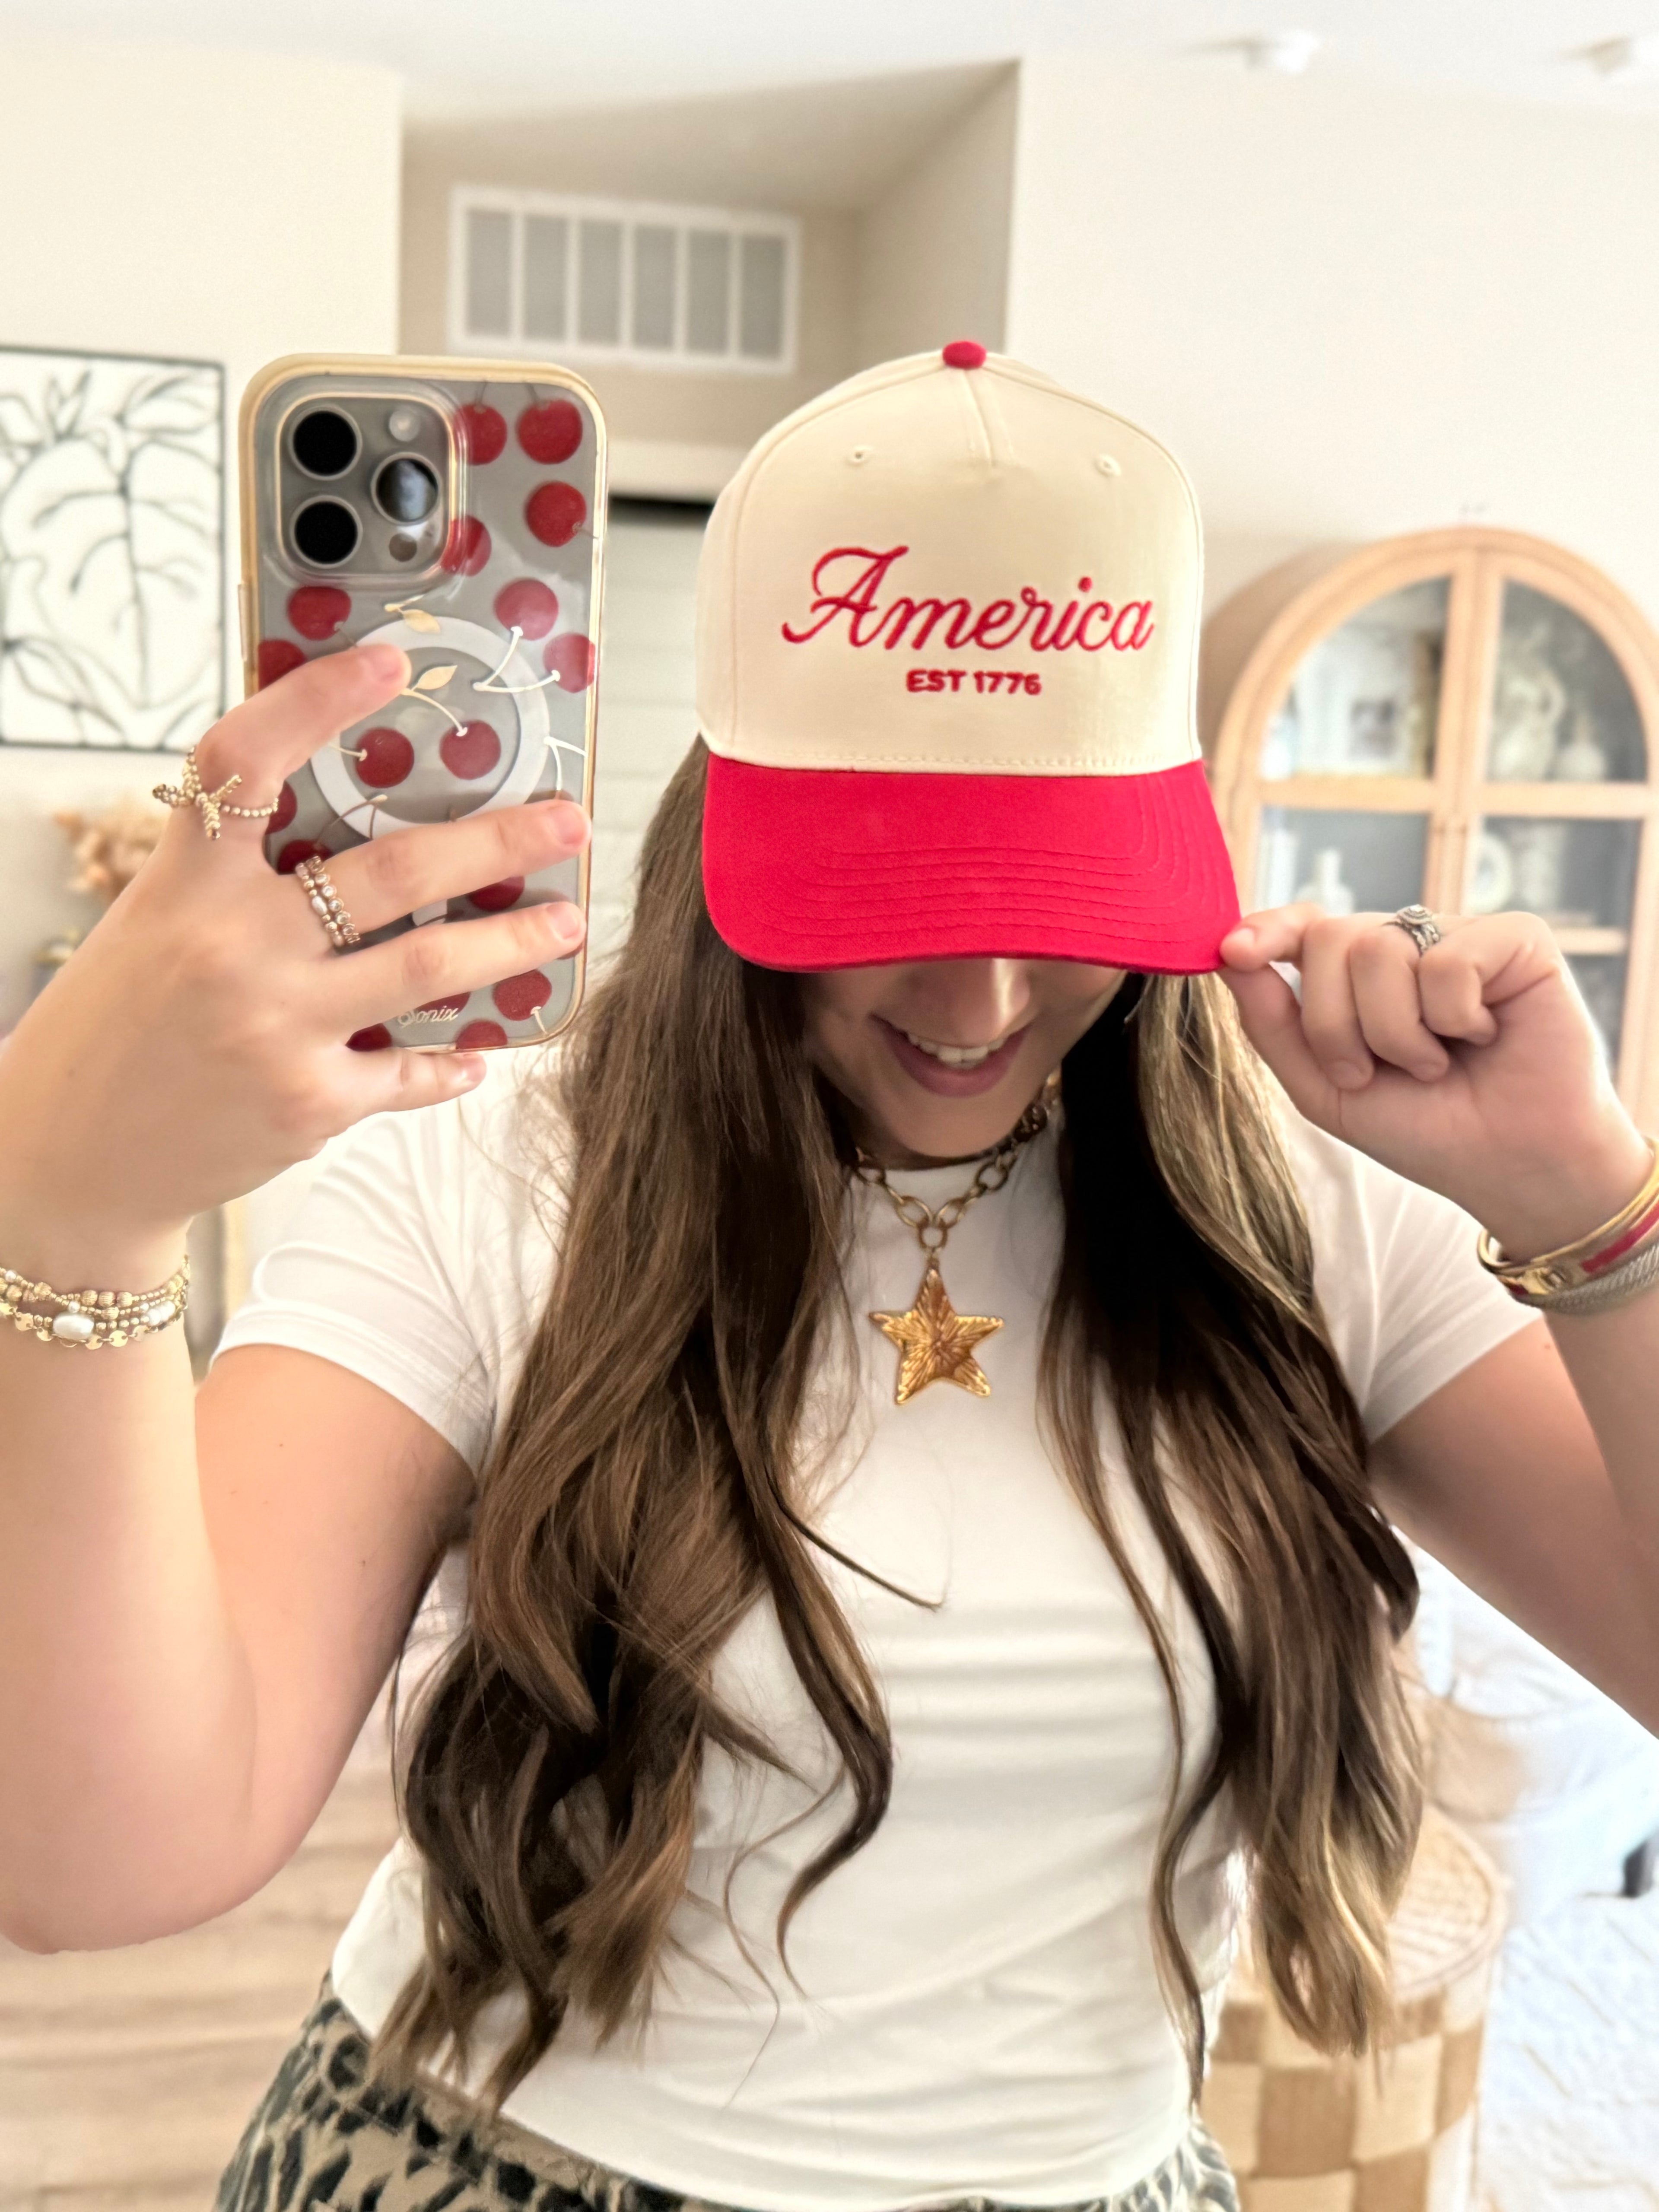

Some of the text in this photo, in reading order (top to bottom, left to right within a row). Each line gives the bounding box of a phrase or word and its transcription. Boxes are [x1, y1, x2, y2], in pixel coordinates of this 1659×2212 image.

[782, 545, 1154, 652] America
[906, 668, 1042, 695] EST 1776
